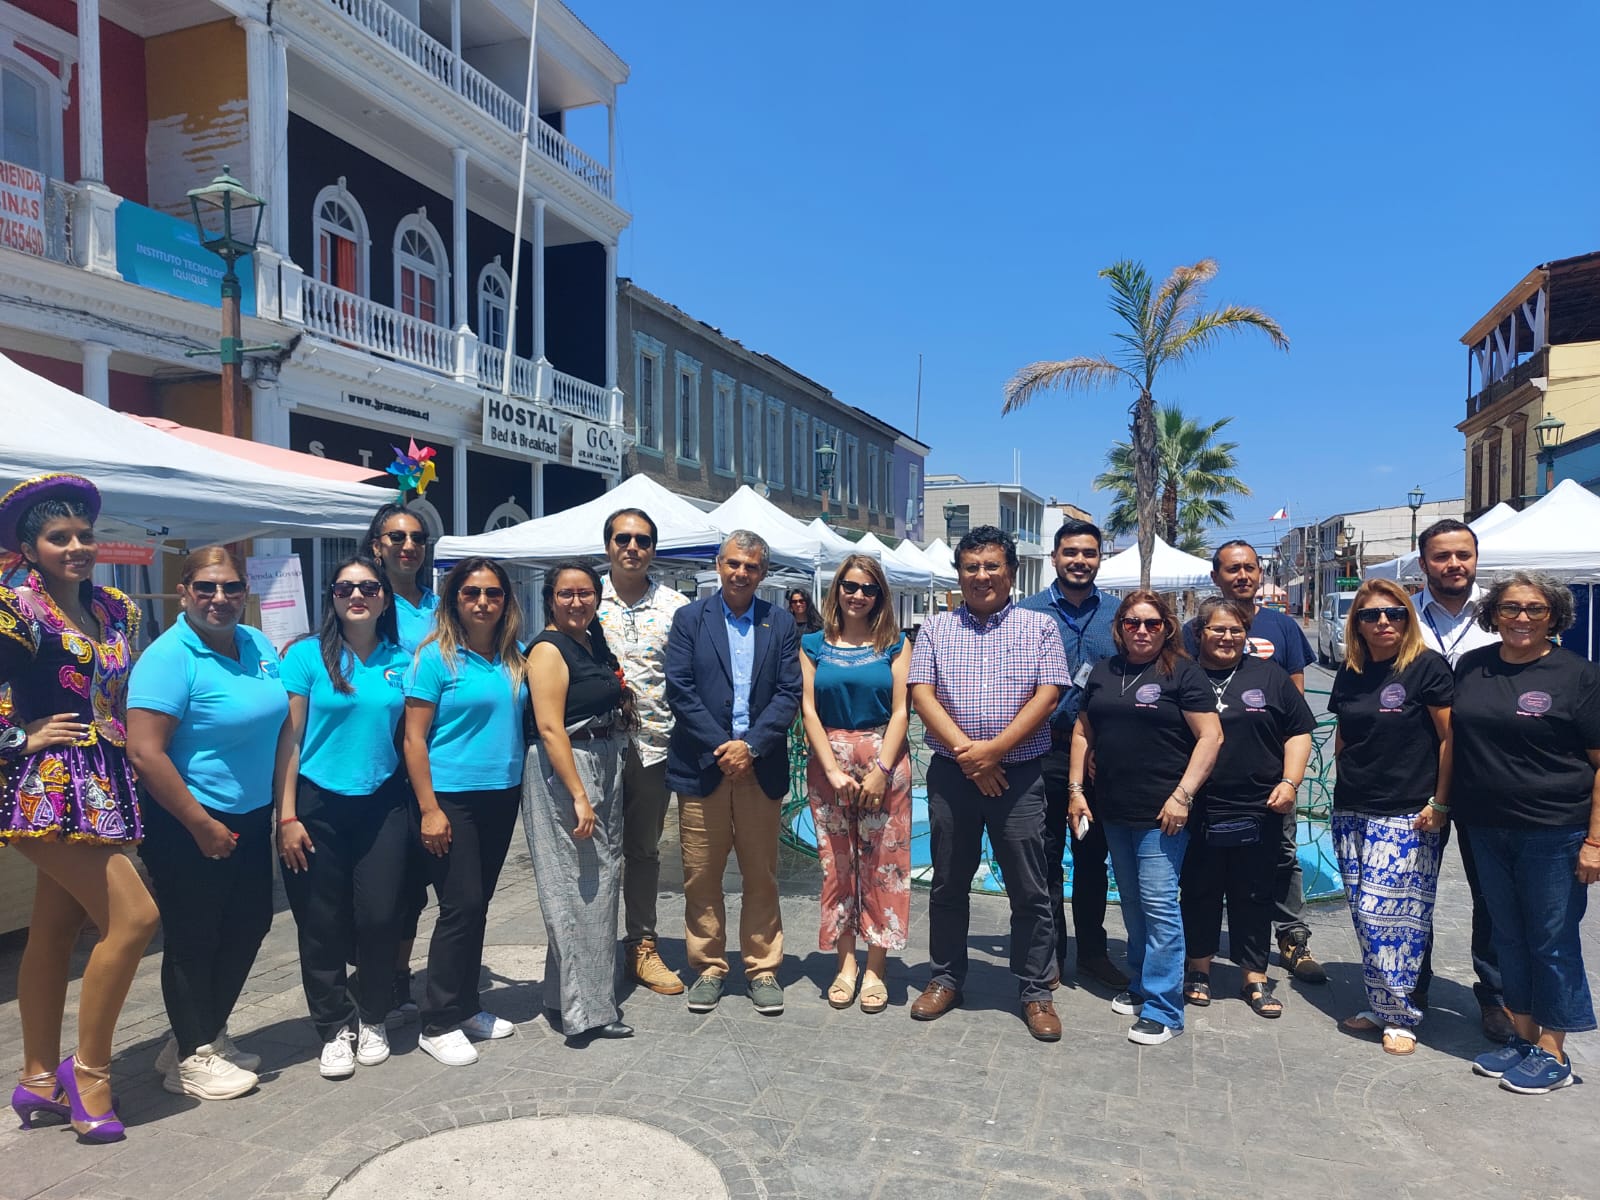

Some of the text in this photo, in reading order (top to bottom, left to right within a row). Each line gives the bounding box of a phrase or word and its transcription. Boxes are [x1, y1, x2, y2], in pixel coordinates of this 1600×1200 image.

[0, 190, 39, 221] INAS
[136, 242, 182, 266] INSTITUTO
[172, 267, 209, 288] IQUIQUE
[488, 398, 558, 436] HOSTAL
[491, 426, 558, 456] Bed & Breakfast
